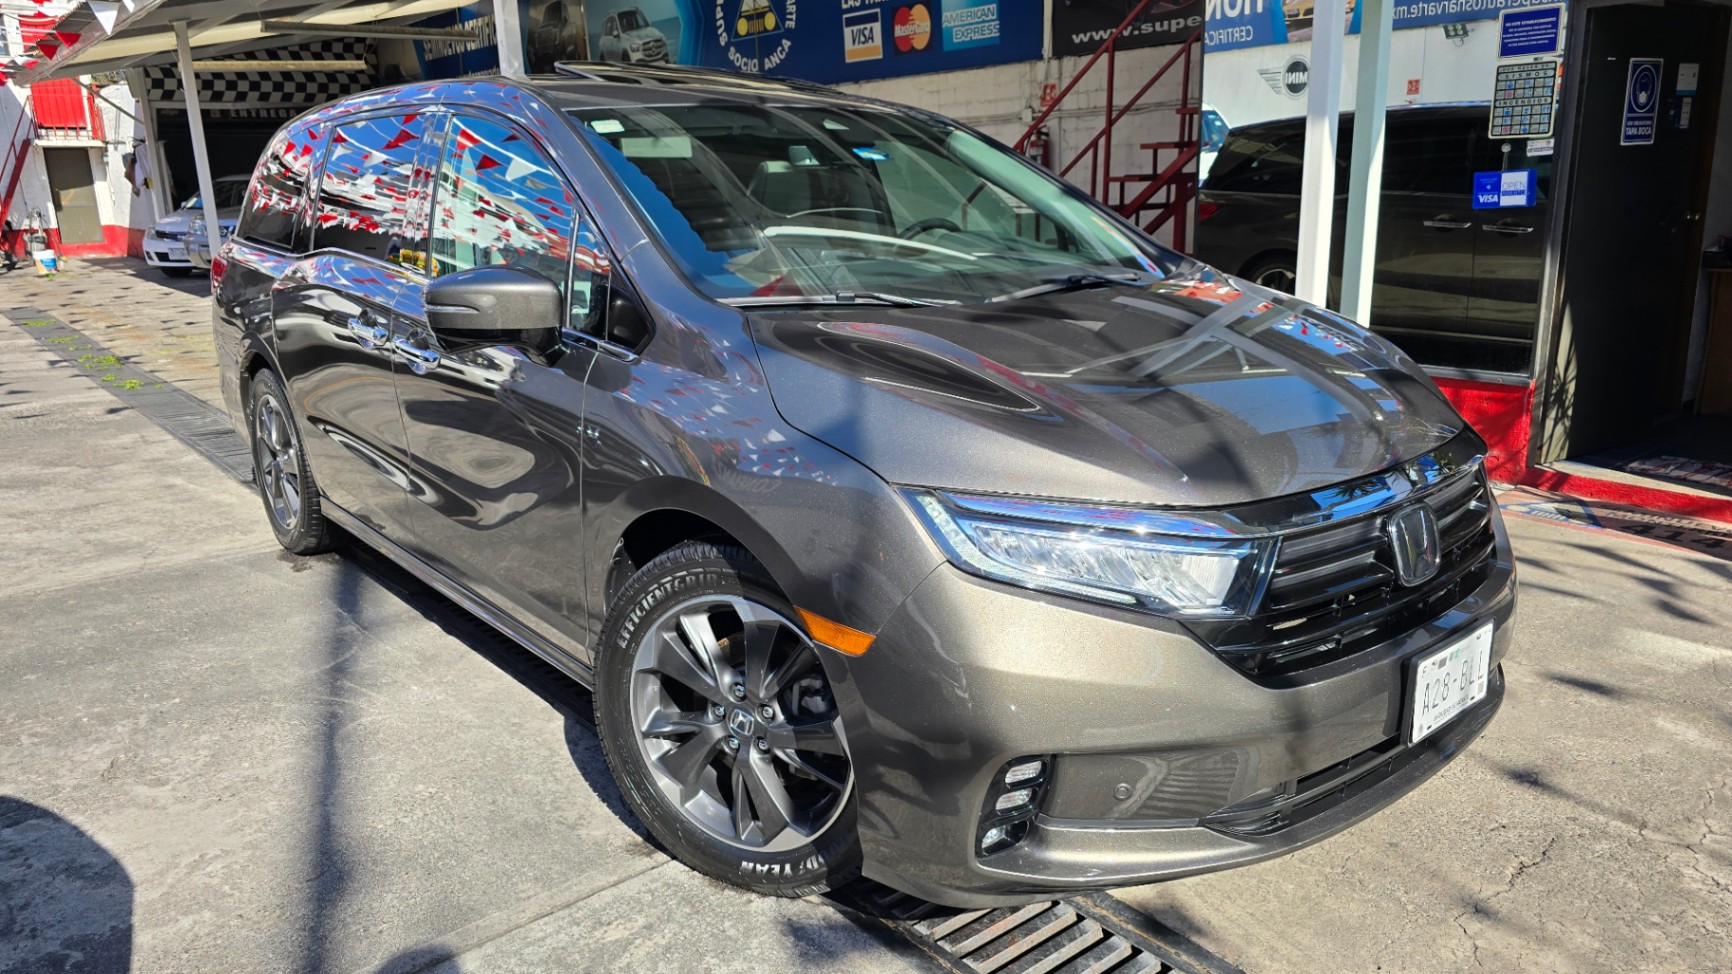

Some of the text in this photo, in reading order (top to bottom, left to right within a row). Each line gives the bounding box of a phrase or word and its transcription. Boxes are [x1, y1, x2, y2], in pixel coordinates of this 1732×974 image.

[942, 6, 996, 26] AMERICAN
[851, 26, 874, 46] VISA
[954, 23, 1000, 41] EXPRESS
[728, 38, 792, 72] SOCIO ANCA
[1504, 71, 1548, 79] SISMOS
[1498, 98, 1548, 106] INCENDIOS
[1502, 181, 1526, 190] OPEN
[1477, 194, 1498, 203] VISA
